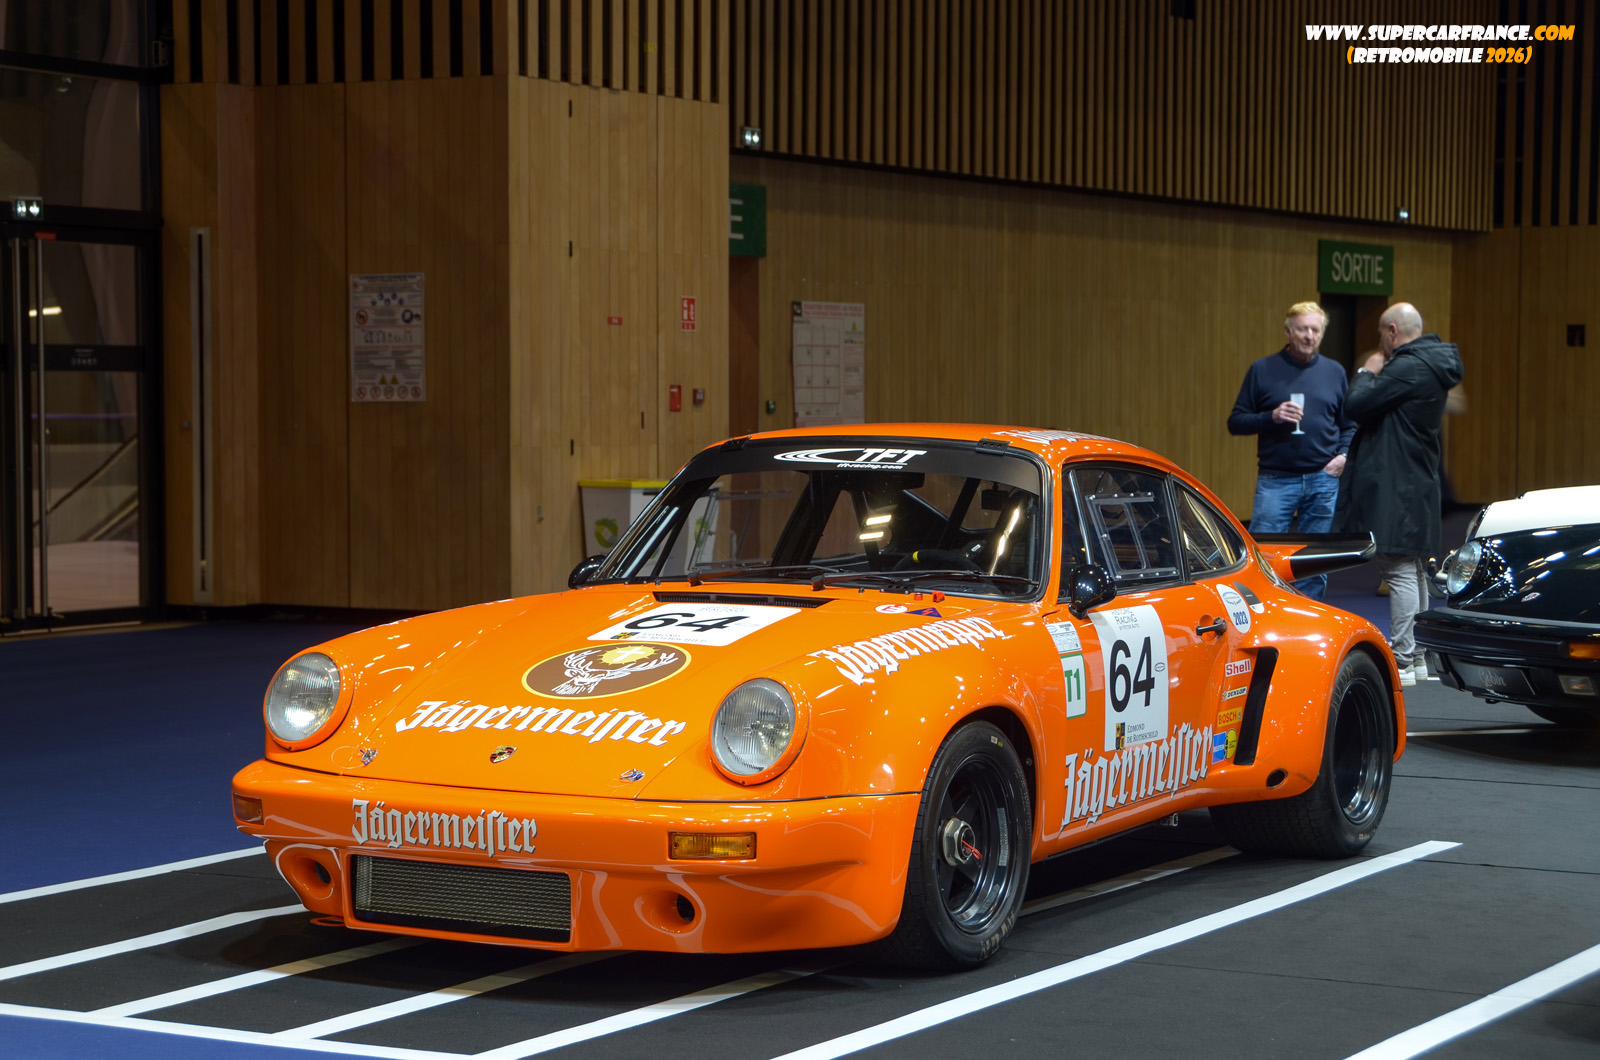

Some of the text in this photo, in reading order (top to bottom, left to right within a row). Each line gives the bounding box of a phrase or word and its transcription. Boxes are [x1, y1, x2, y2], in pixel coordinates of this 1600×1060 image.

[1331, 251, 1384, 285] SORTIE
[855, 448, 928, 463] TFT
[624, 612, 750, 633] 64
[1114, 613, 1138, 625] RACING
[1232, 610, 1249, 626] 2023
[1109, 636, 1156, 713] 64
[1226, 660, 1251, 676] Shell
[1064, 668, 1081, 703] T1
[1227, 688, 1247, 698] DUNLOP
[1218, 711, 1237, 725] BOSCH
